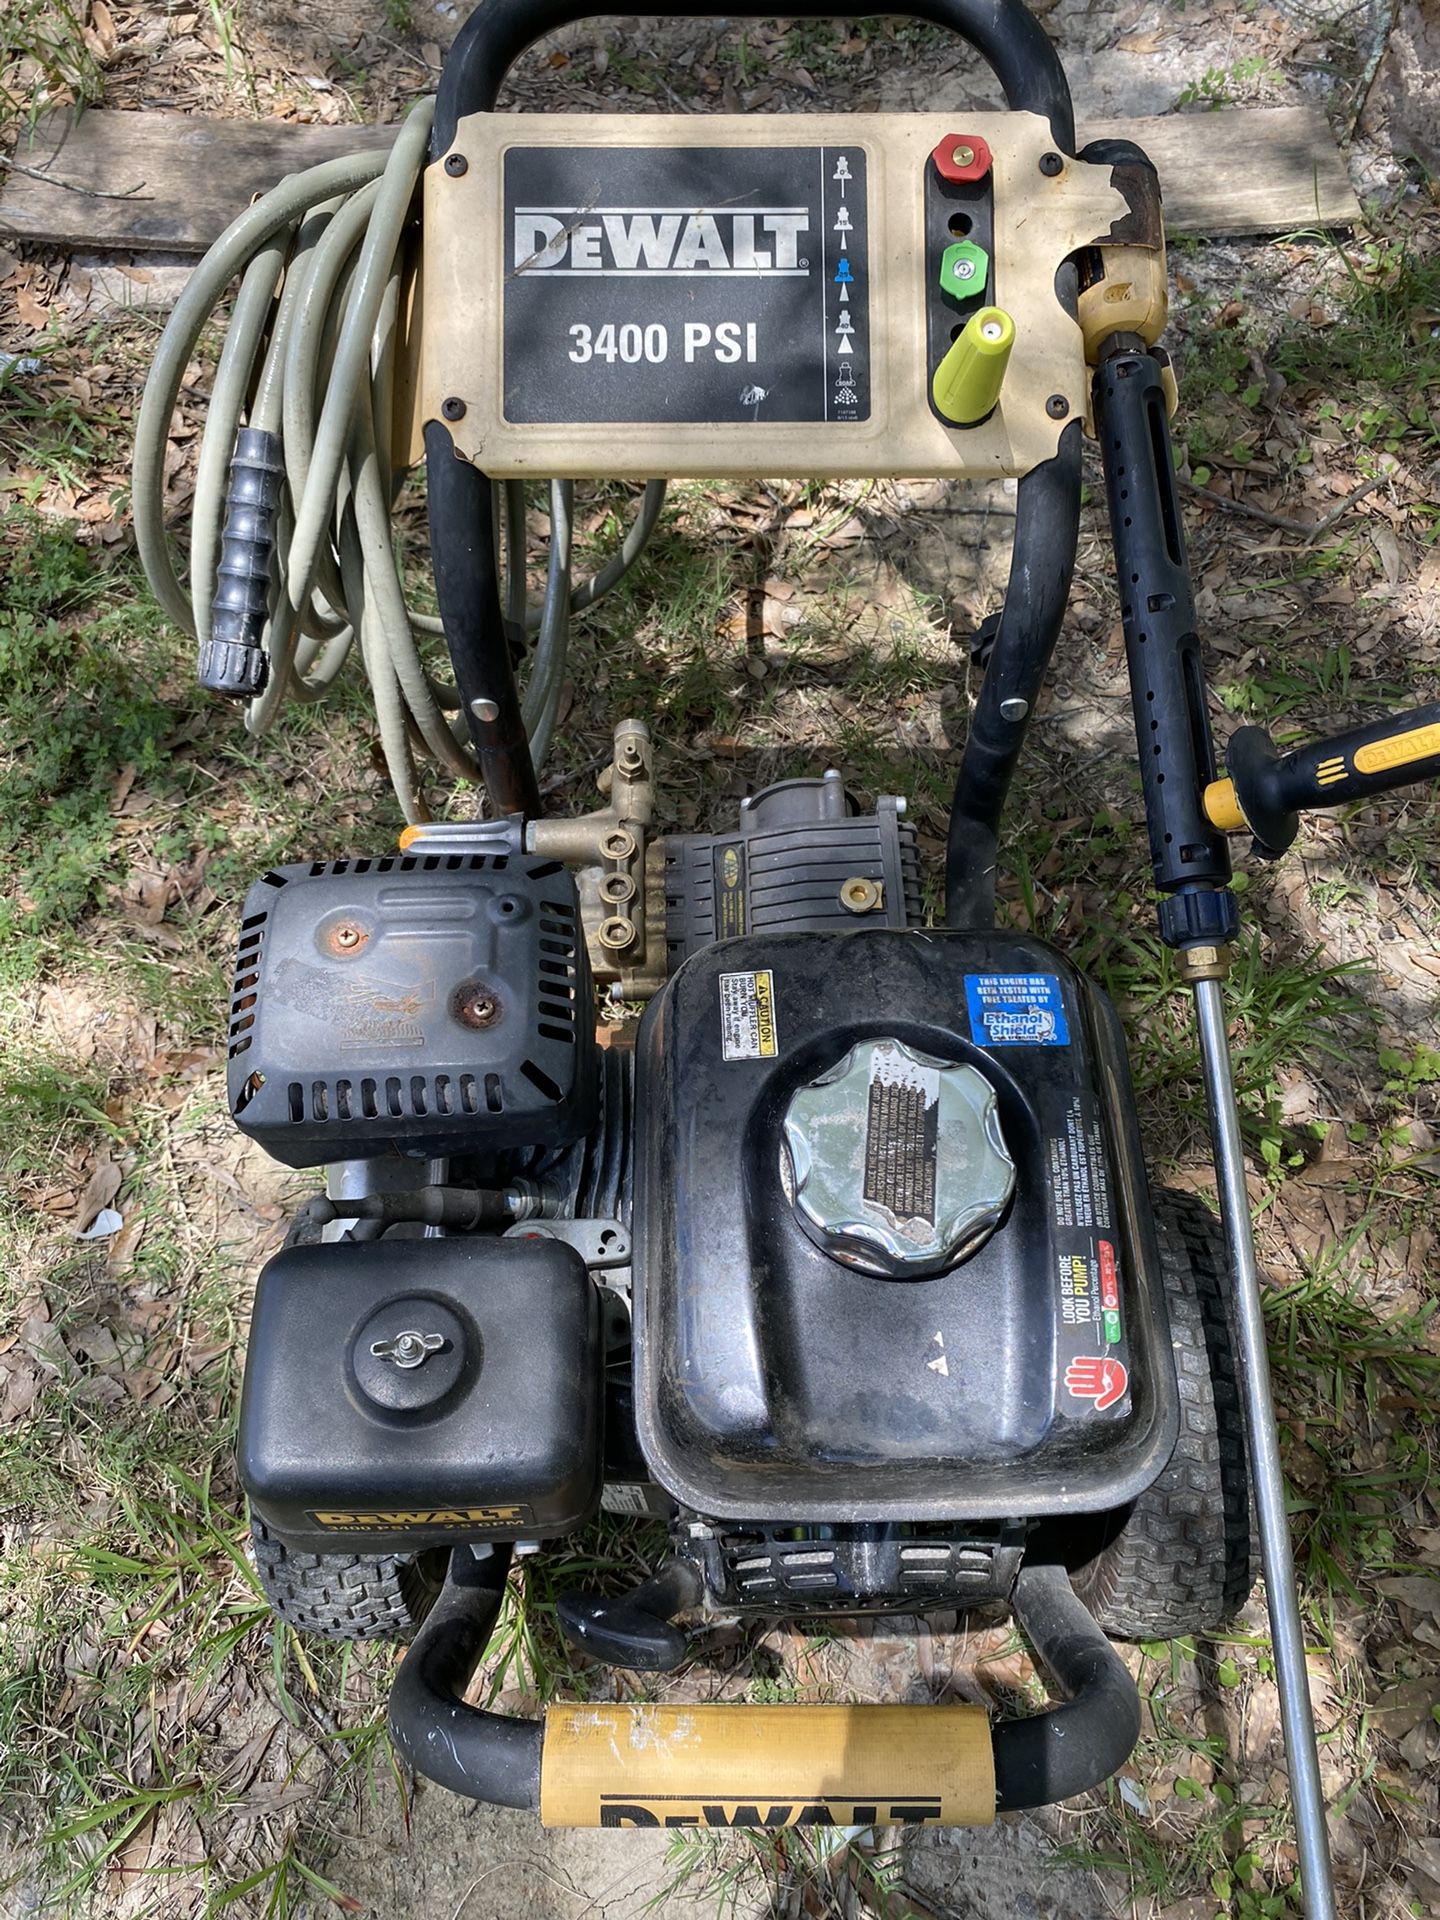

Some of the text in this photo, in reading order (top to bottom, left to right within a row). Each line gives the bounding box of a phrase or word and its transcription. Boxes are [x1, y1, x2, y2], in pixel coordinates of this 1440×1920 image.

[568, 323, 757, 363] 3400 PSI
[1364, 732, 1436, 766] DEWALT
[730, 978, 738, 993] Stay
[730, 996, 739, 1014] away
[746, 977, 754, 992] HOT
[750, 1031, 758, 1048] CAN
[758, 996, 771, 1042] CAUTION
[985, 1013, 1042, 1023] Ethanol
[732, 1023, 740, 1048] engine
[992, 1025, 1036, 1035] Shield
[890, 1096, 898, 1128] USUARIO
[908, 1118, 915, 1128] DE
[871, 1128, 877, 1137] OF
[1067, 1118, 1075, 1134] DONT
[876, 1161, 886, 1203] NDERSTAND
[881, 1086, 889, 1114] MANUA
[1049, 1138, 1060, 1173] CONTAINING
[1058, 1137, 1067, 1166] ETHANOL!
[1069, 1135, 1079, 1170] CARBURANT
[1096, 1146, 1102, 1154] DE
[869, 1156, 877, 1168] THE
[906, 1159, 914, 1172] LES
[867, 1170, 876, 1197] REDUCE
[1072, 1171, 1080, 1179] UN
[1062, 1182, 1070, 1197] THAN
[1073, 1181, 1081, 1192] PAS
[1083, 1194, 1090, 1202] EN
[1094, 1193, 1102, 1215] UTILICE
[1057, 1217, 1064, 1225] DO
[1063, 1199, 1073, 1225] GREATER
[1083, 1203, 1092, 1226] TENEUR
[1059, 1255, 1075, 1324] LOOK BEFORE
[1072, 1255, 1090, 1323] YOU PUMP!
[1089, 1260, 1101, 1320] Ethanol Percentage
[315, 1507, 520, 1525] DEWALT
